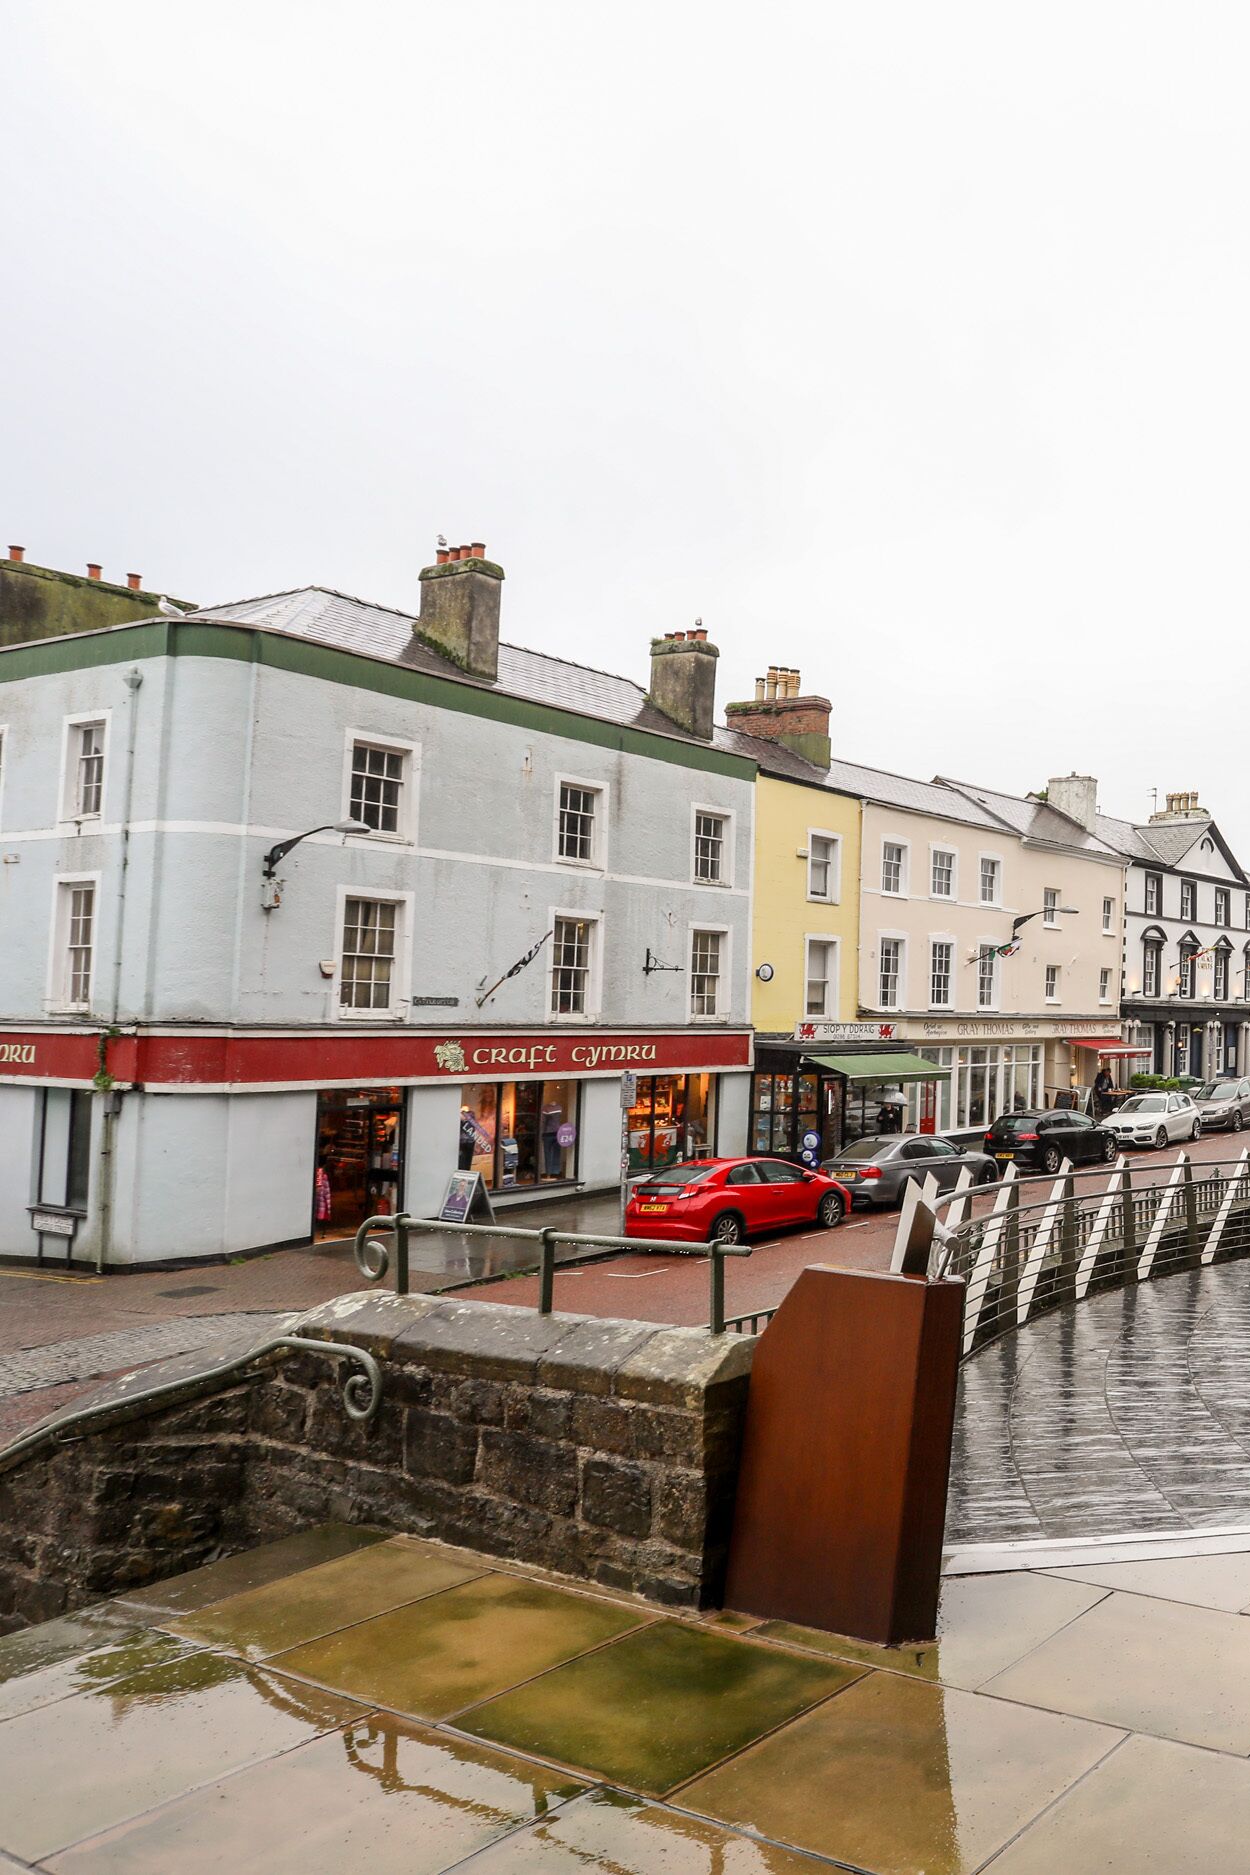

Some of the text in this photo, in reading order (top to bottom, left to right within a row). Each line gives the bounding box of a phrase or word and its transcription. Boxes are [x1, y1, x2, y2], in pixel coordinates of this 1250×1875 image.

[823, 1024, 875, 1034] SIOP Y DDRAIG
[957, 1023, 1014, 1035] GRAY THOMAS
[1052, 1024, 1097, 1034] GRAY THOMAS
[473, 1045, 657, 1069] CRAFT CYMRU
[462, 1123, 493, 1153] LANDED
[560, 1135, 574, 1143] £24
